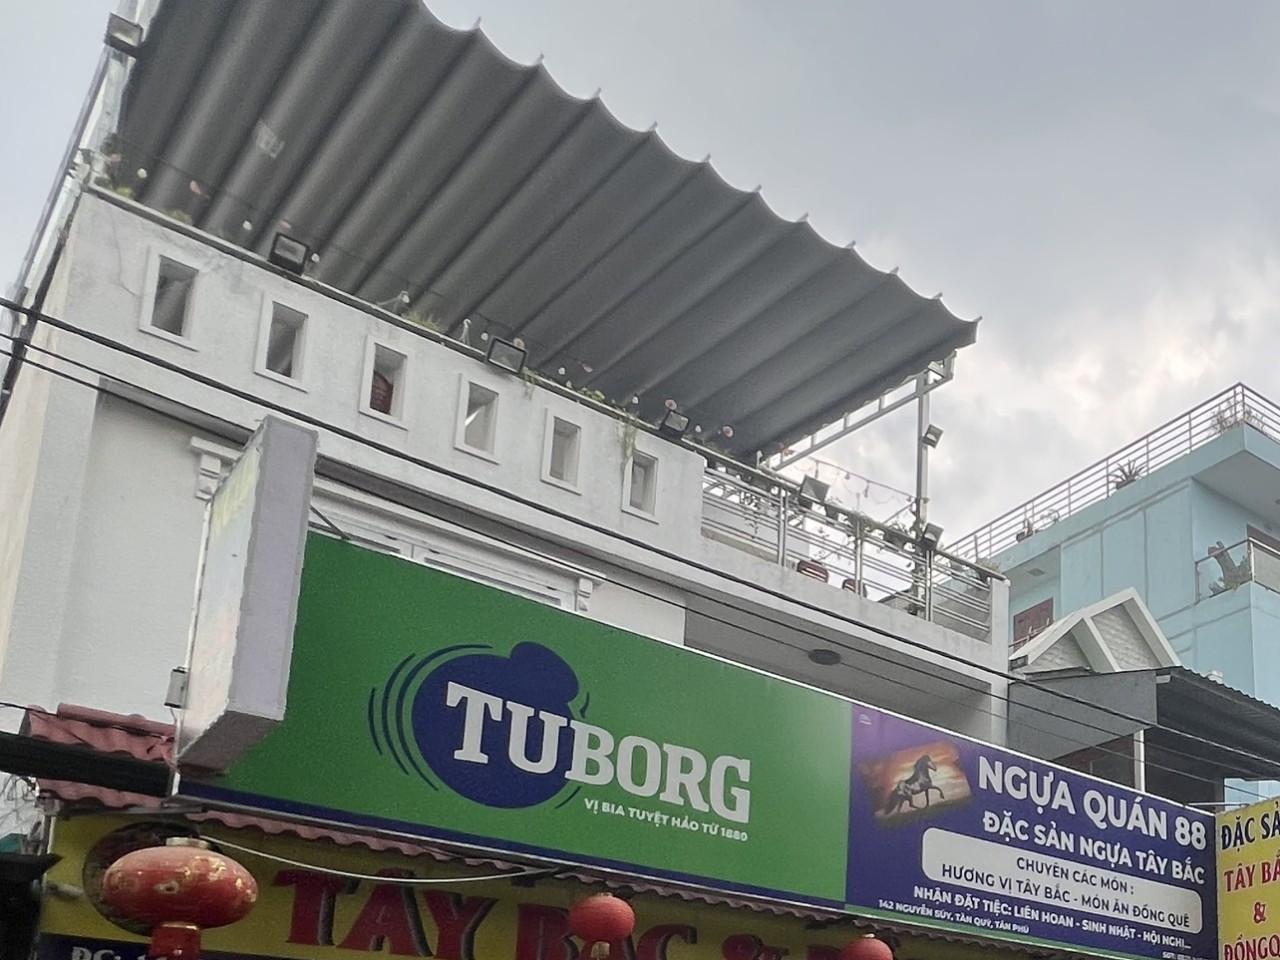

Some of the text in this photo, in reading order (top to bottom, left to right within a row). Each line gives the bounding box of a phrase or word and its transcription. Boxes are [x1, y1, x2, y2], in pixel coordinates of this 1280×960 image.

[445, 681, 751, 824] TUBORG
[584, 798, 599, 814] VỊ
[601, 802, 625, 816] BIA
[628, 807, 670, 828] TUYỆT
[671, 815, 699, 831] HẢO
[720, 827, 748, 842] 1880
[978, 756, 1207, 850] NGỰA QUÁN 88
[982, 810, 1205, 885] ĐẶC SẢN NGỰA TÂY BẮC
[1221, 816, 1256, 852] ĐẶC
[941, 863, 995, 887] HƯƠNG
[999, 876, 1012, 894] VỊ
[1016, 878, 1041, 897] TÂY
[1044, 883, 1071, 903] BẮC
[1081, 894, 1110, 911] MÓN
[1112, 898, 1129, 915] ĂN
[1167, 913, 1190, 928] QUÊ
[1016, 857, 1069, 880] CHUYÊN
[1072, 869, 1098, 887] CÁC
[1100, 876, 1128, 893] MÓN
[1224, 862, 1256, 892] TÂY
[878, 899, 894, 910] 142
[913, 885, 951, 905] NHẬN
[954, 892, 981, 911] ĐẶT
[1014, 901, 1040, 921] LIÊN
[1041, 911, 1074, 928] HOAN
[1082, 919, 1107, 934] SINH
[1108, 924, 1136, 940] NHẬT
[1143, 930, 1161, 945] HỘI
[1253, 901, 1267, 924] &
